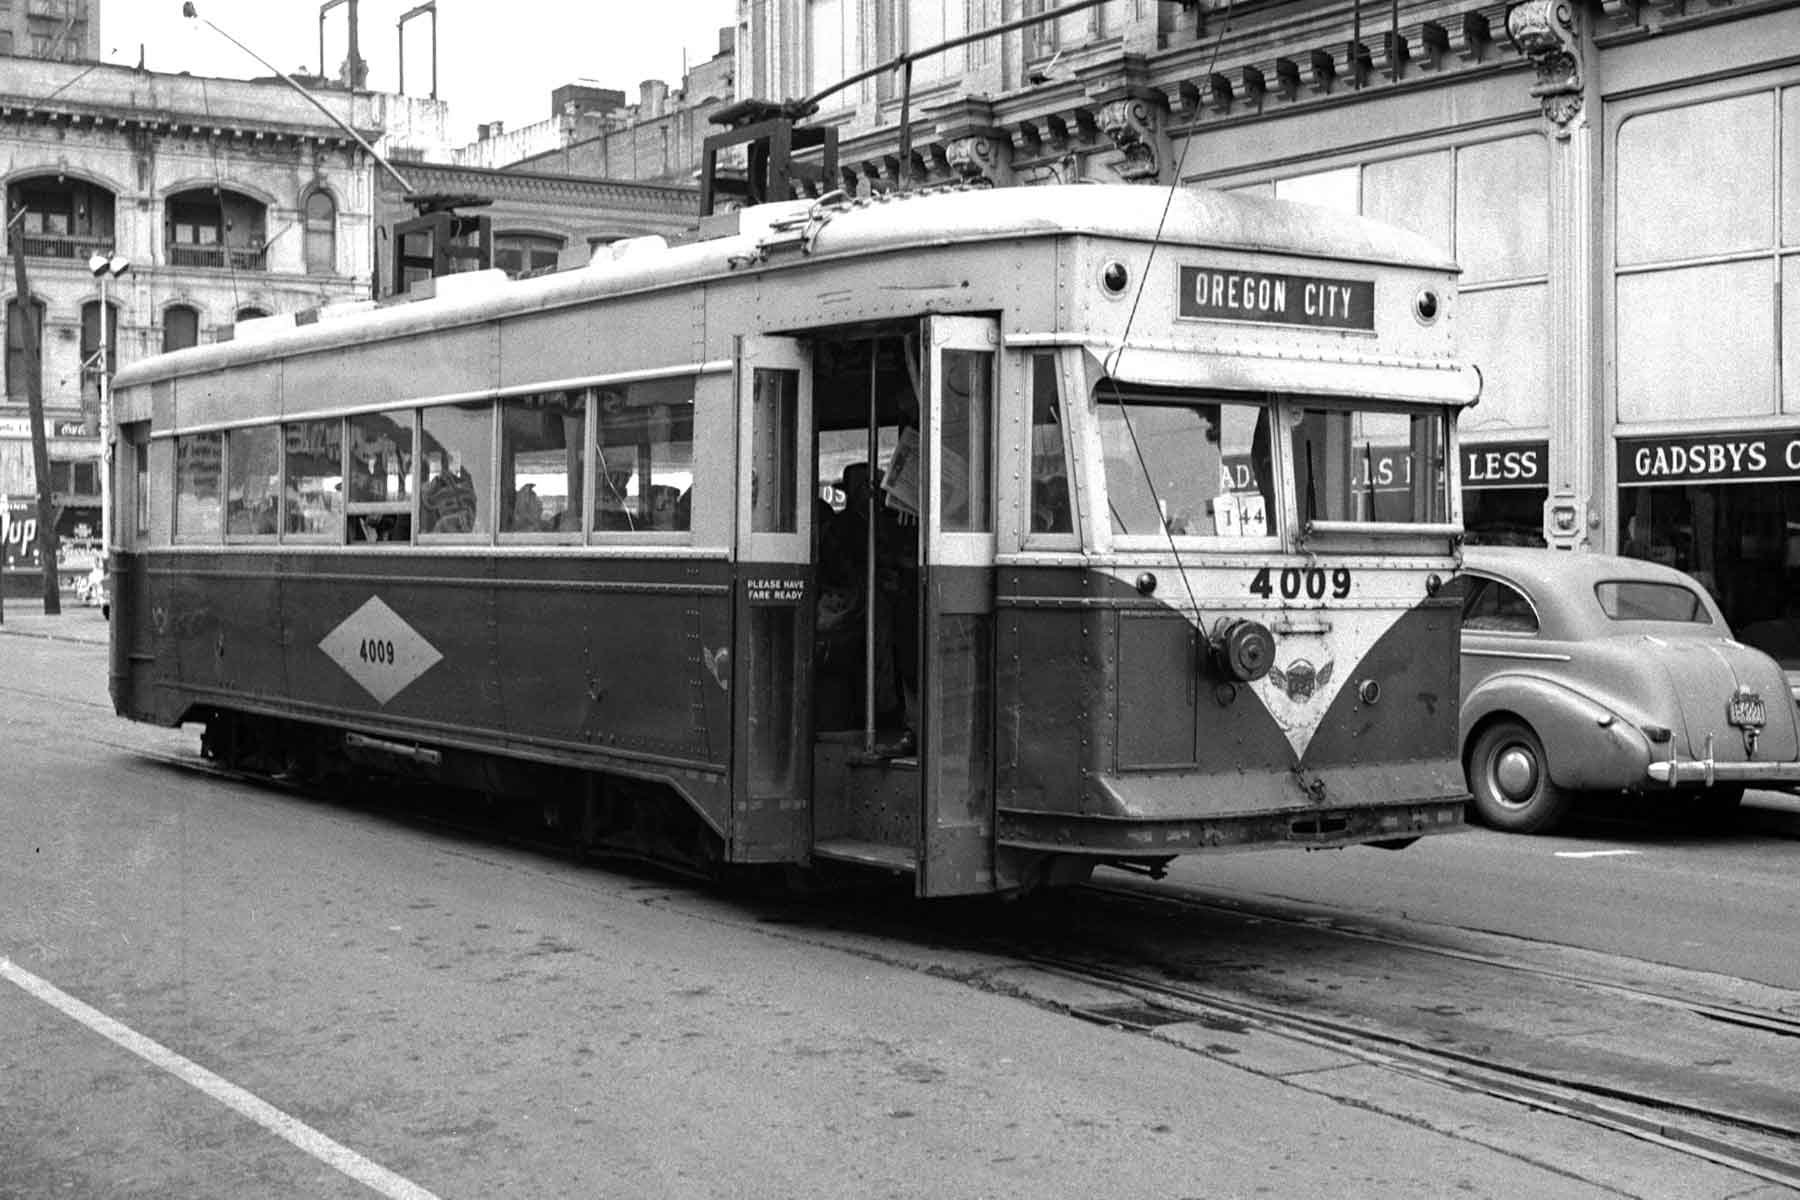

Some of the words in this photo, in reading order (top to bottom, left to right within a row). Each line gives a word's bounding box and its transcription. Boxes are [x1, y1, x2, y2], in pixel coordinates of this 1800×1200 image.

[1195, 272, 1286, 312] OREGON
[1304, 282, 1352, 319] CITY
[1468, 451, 1537, 480] LESS
[1635, 441, 1767, 476] GADSBYS
[747, 579, 781, 589] PLEASE
[783, 579, 804, 589] HAVE
[748, 590, 770, 600] FARE
[774, 590, 803, 600] READY
[1250, 567, 1351, 599] 4009
[360, 637, 394, 665] 4009
